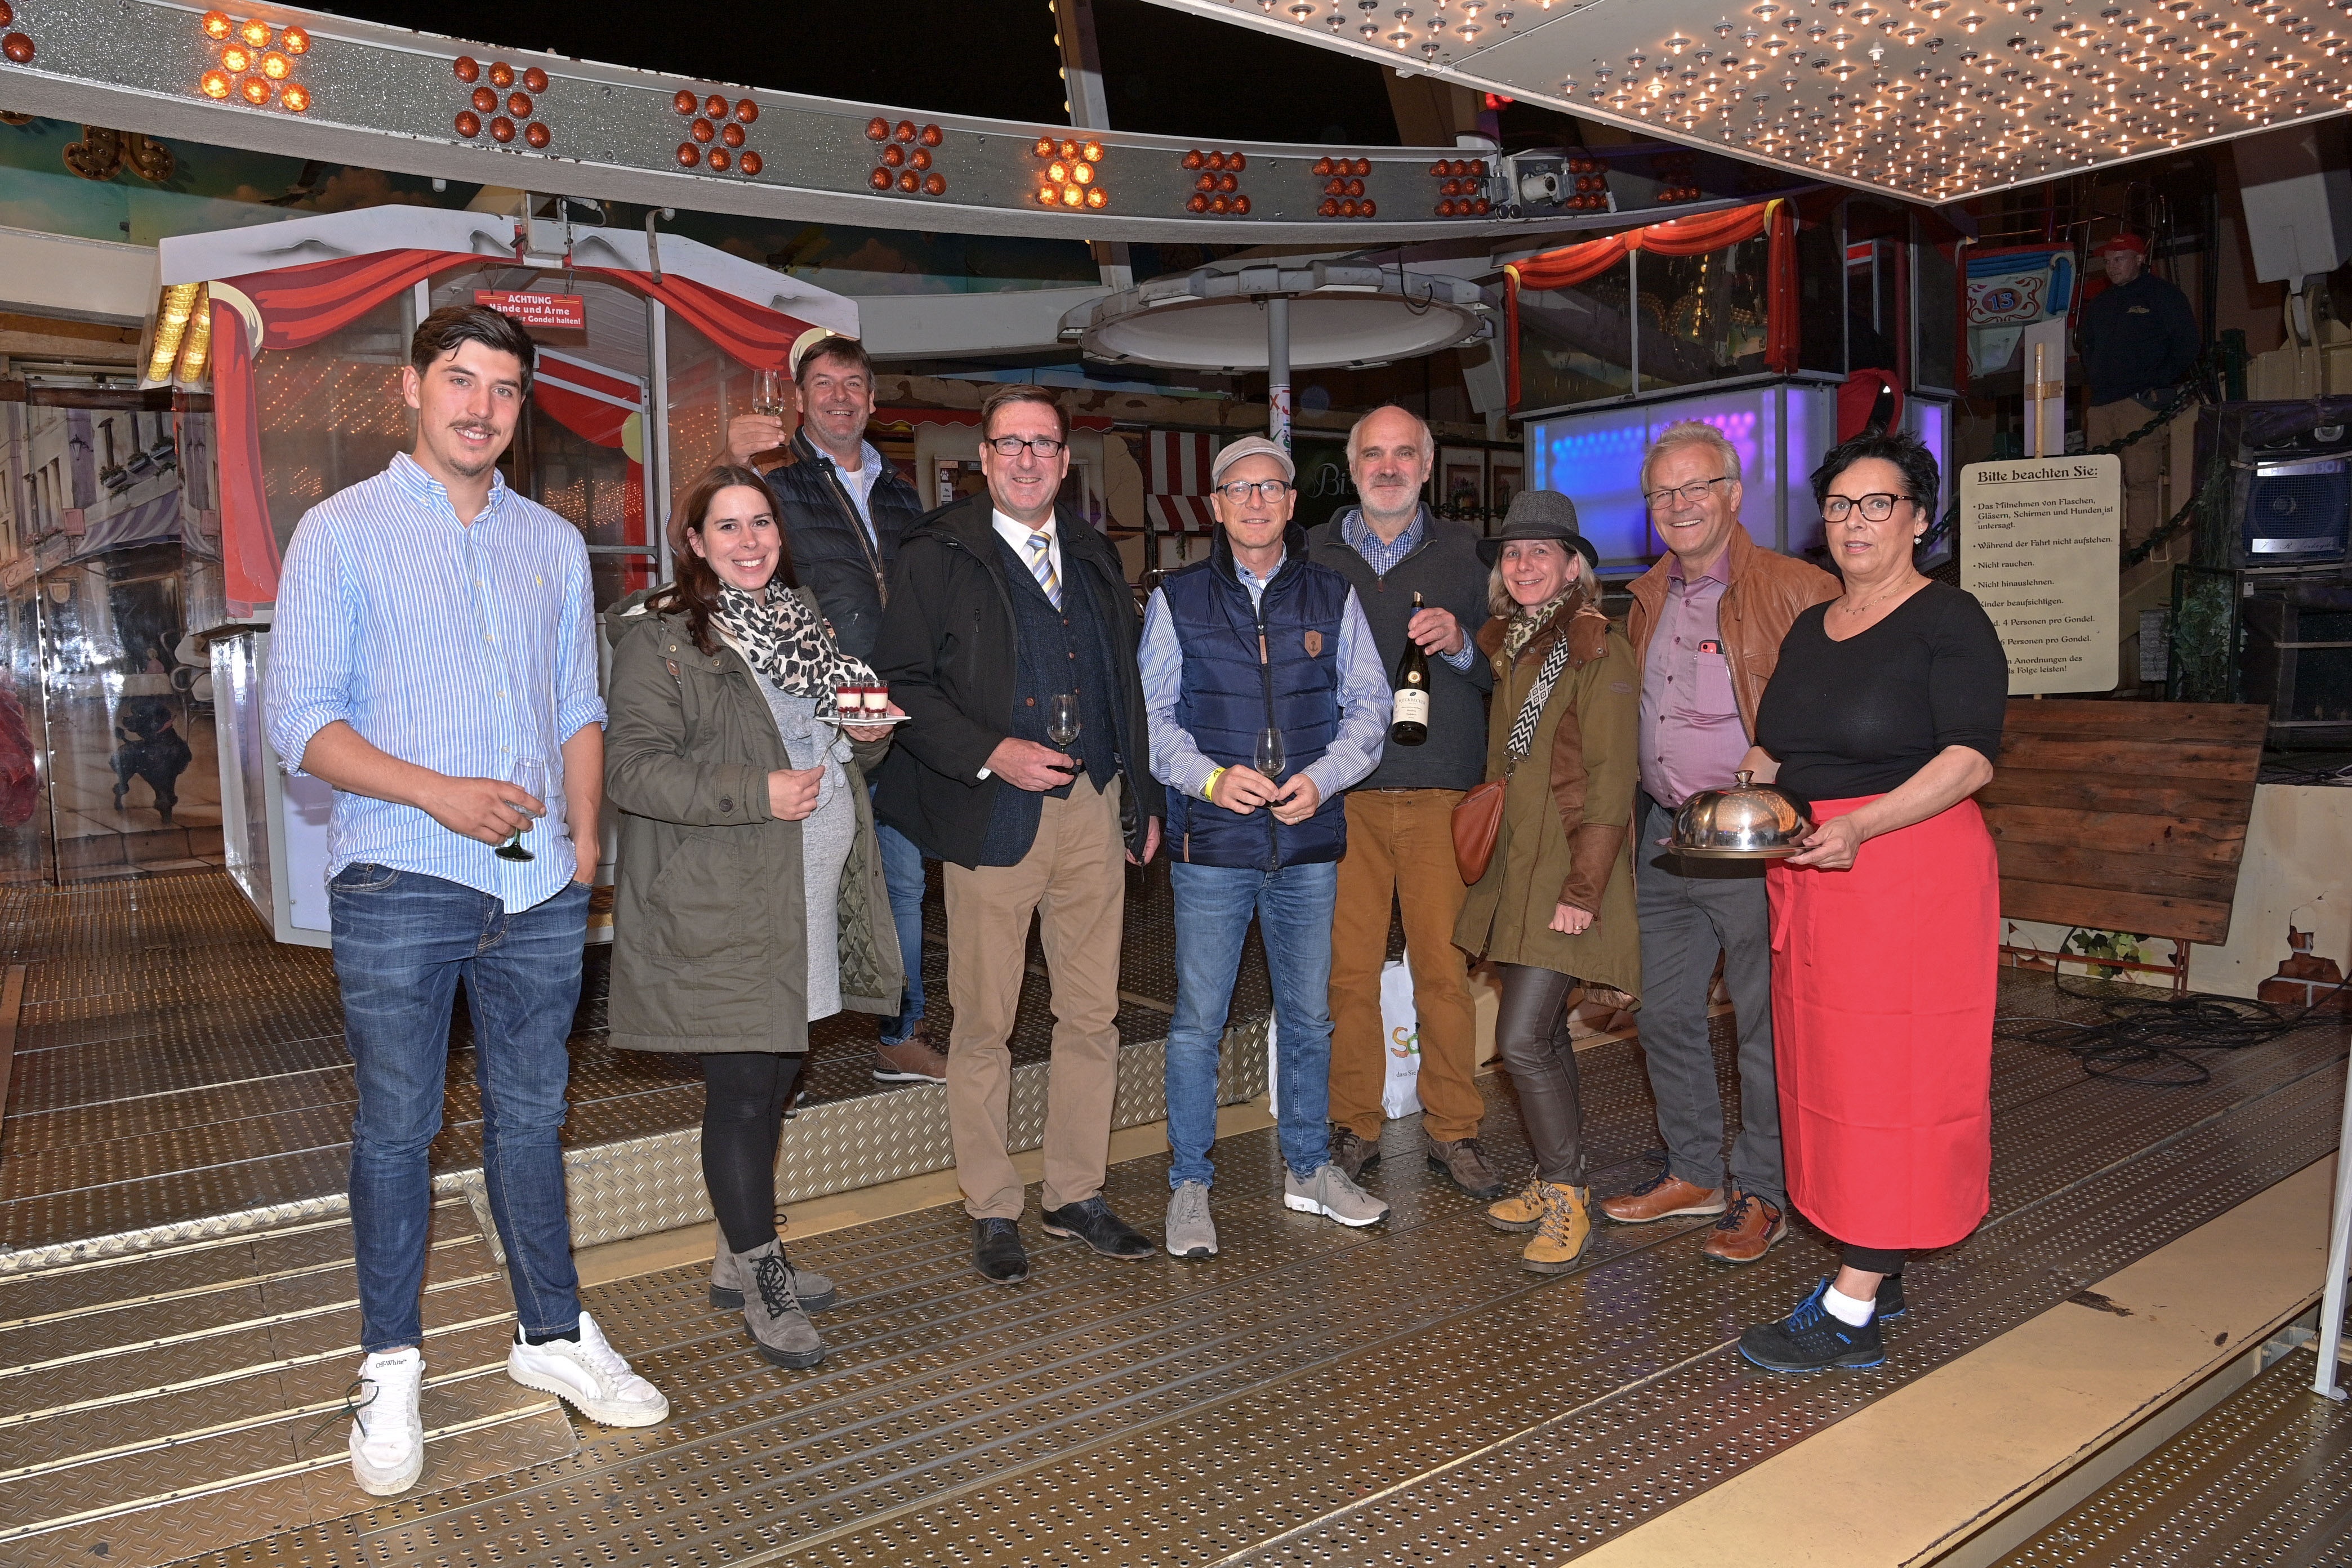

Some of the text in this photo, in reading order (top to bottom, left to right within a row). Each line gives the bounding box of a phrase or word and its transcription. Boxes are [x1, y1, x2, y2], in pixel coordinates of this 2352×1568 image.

[508, 295, 551, 305] ACHTUNG
[1989, 292, 2015, 310] 13
[544, 306, 569, 315] Arme
[1978, 466, 2098, 483] Bitte beachten Sie:
[2059, 498, 2096, 507] Flaschen,
[2074, 536, 2113, 545] aufstehen.
[2007, 598, 2064, 607] beaufsichtigen.
[1836, 1332, 1851, 1344] atlas
